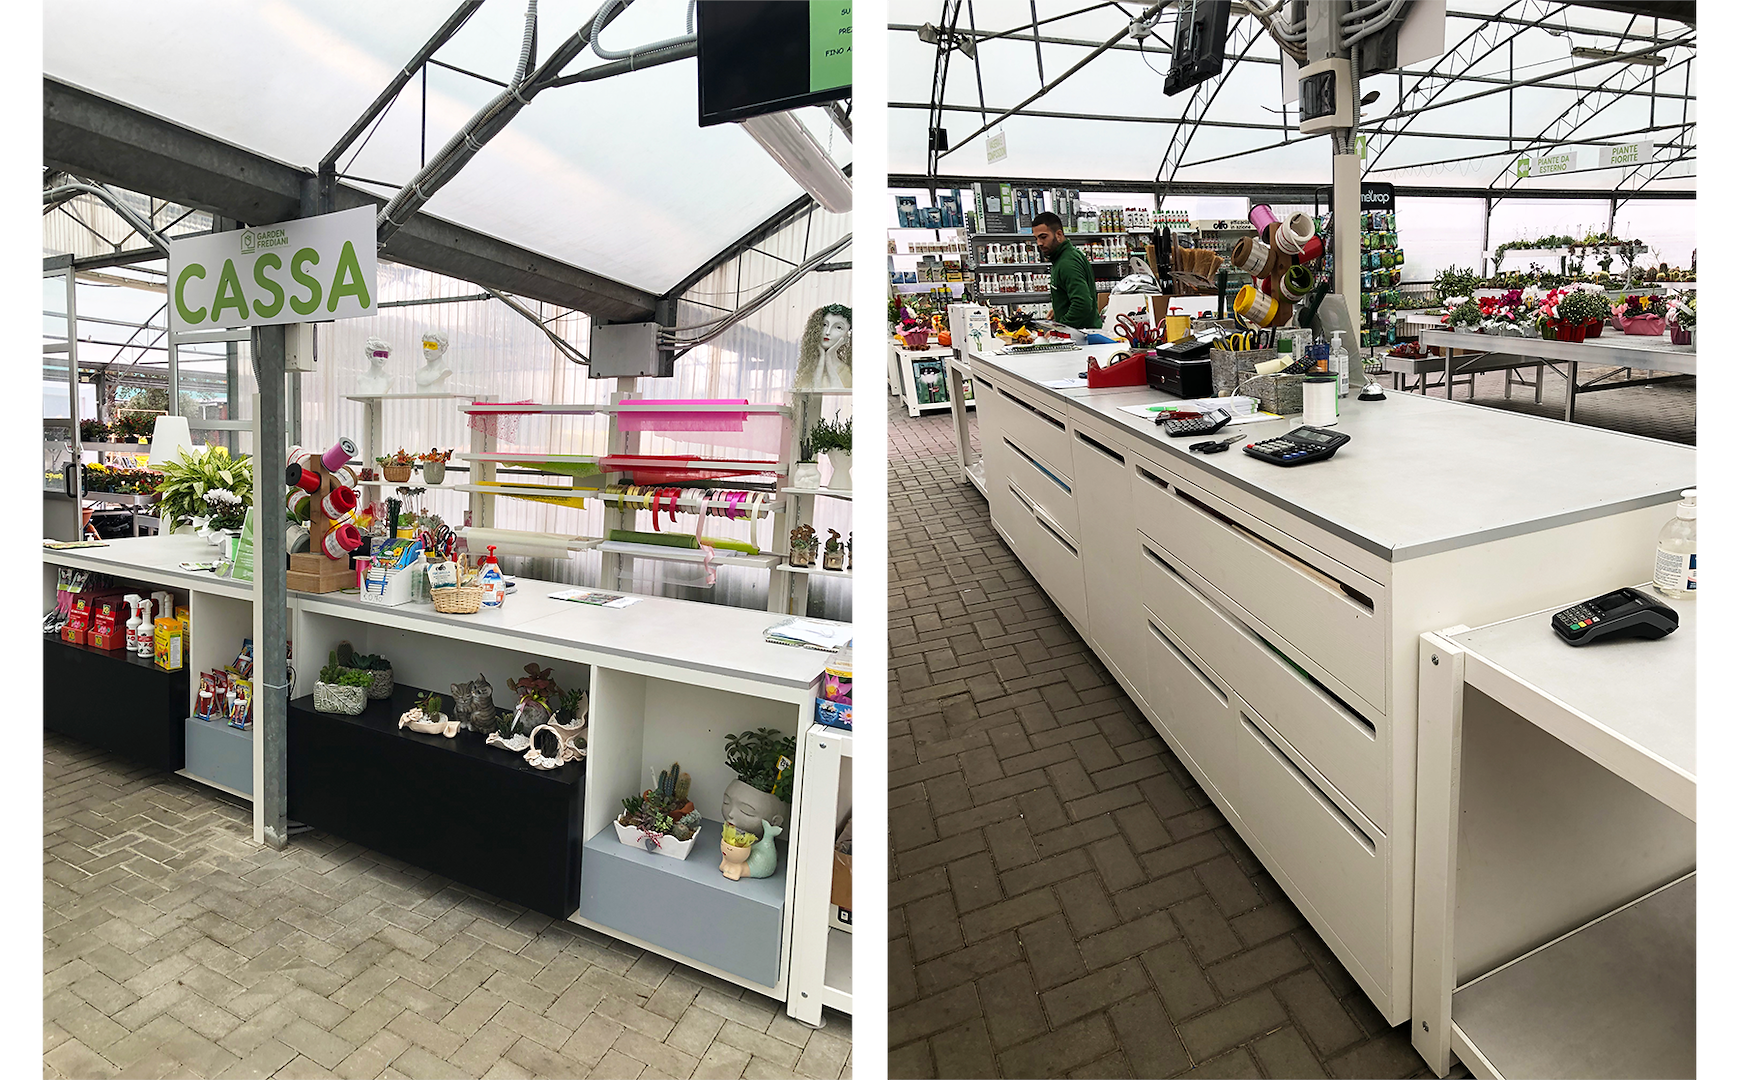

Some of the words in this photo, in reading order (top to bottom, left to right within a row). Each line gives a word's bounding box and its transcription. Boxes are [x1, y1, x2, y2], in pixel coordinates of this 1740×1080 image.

[841, 8, 851, 16] SU
[825, 47, 844, 57] FINO
[1611, 144, 1638, 155] PIANTE
[1537, 156, 1560, 166] PIANTE
[1560, 155, 1570, 164] DA
[1610, 153, 1638, 164] FIORITE
[1539, 163, 1568, 174] ESTERNO
[256, 229, 285, 241] GARDEN
[256, 236, 289, 249] FREDIANI
[174, 240, 371, 325] CASSA
